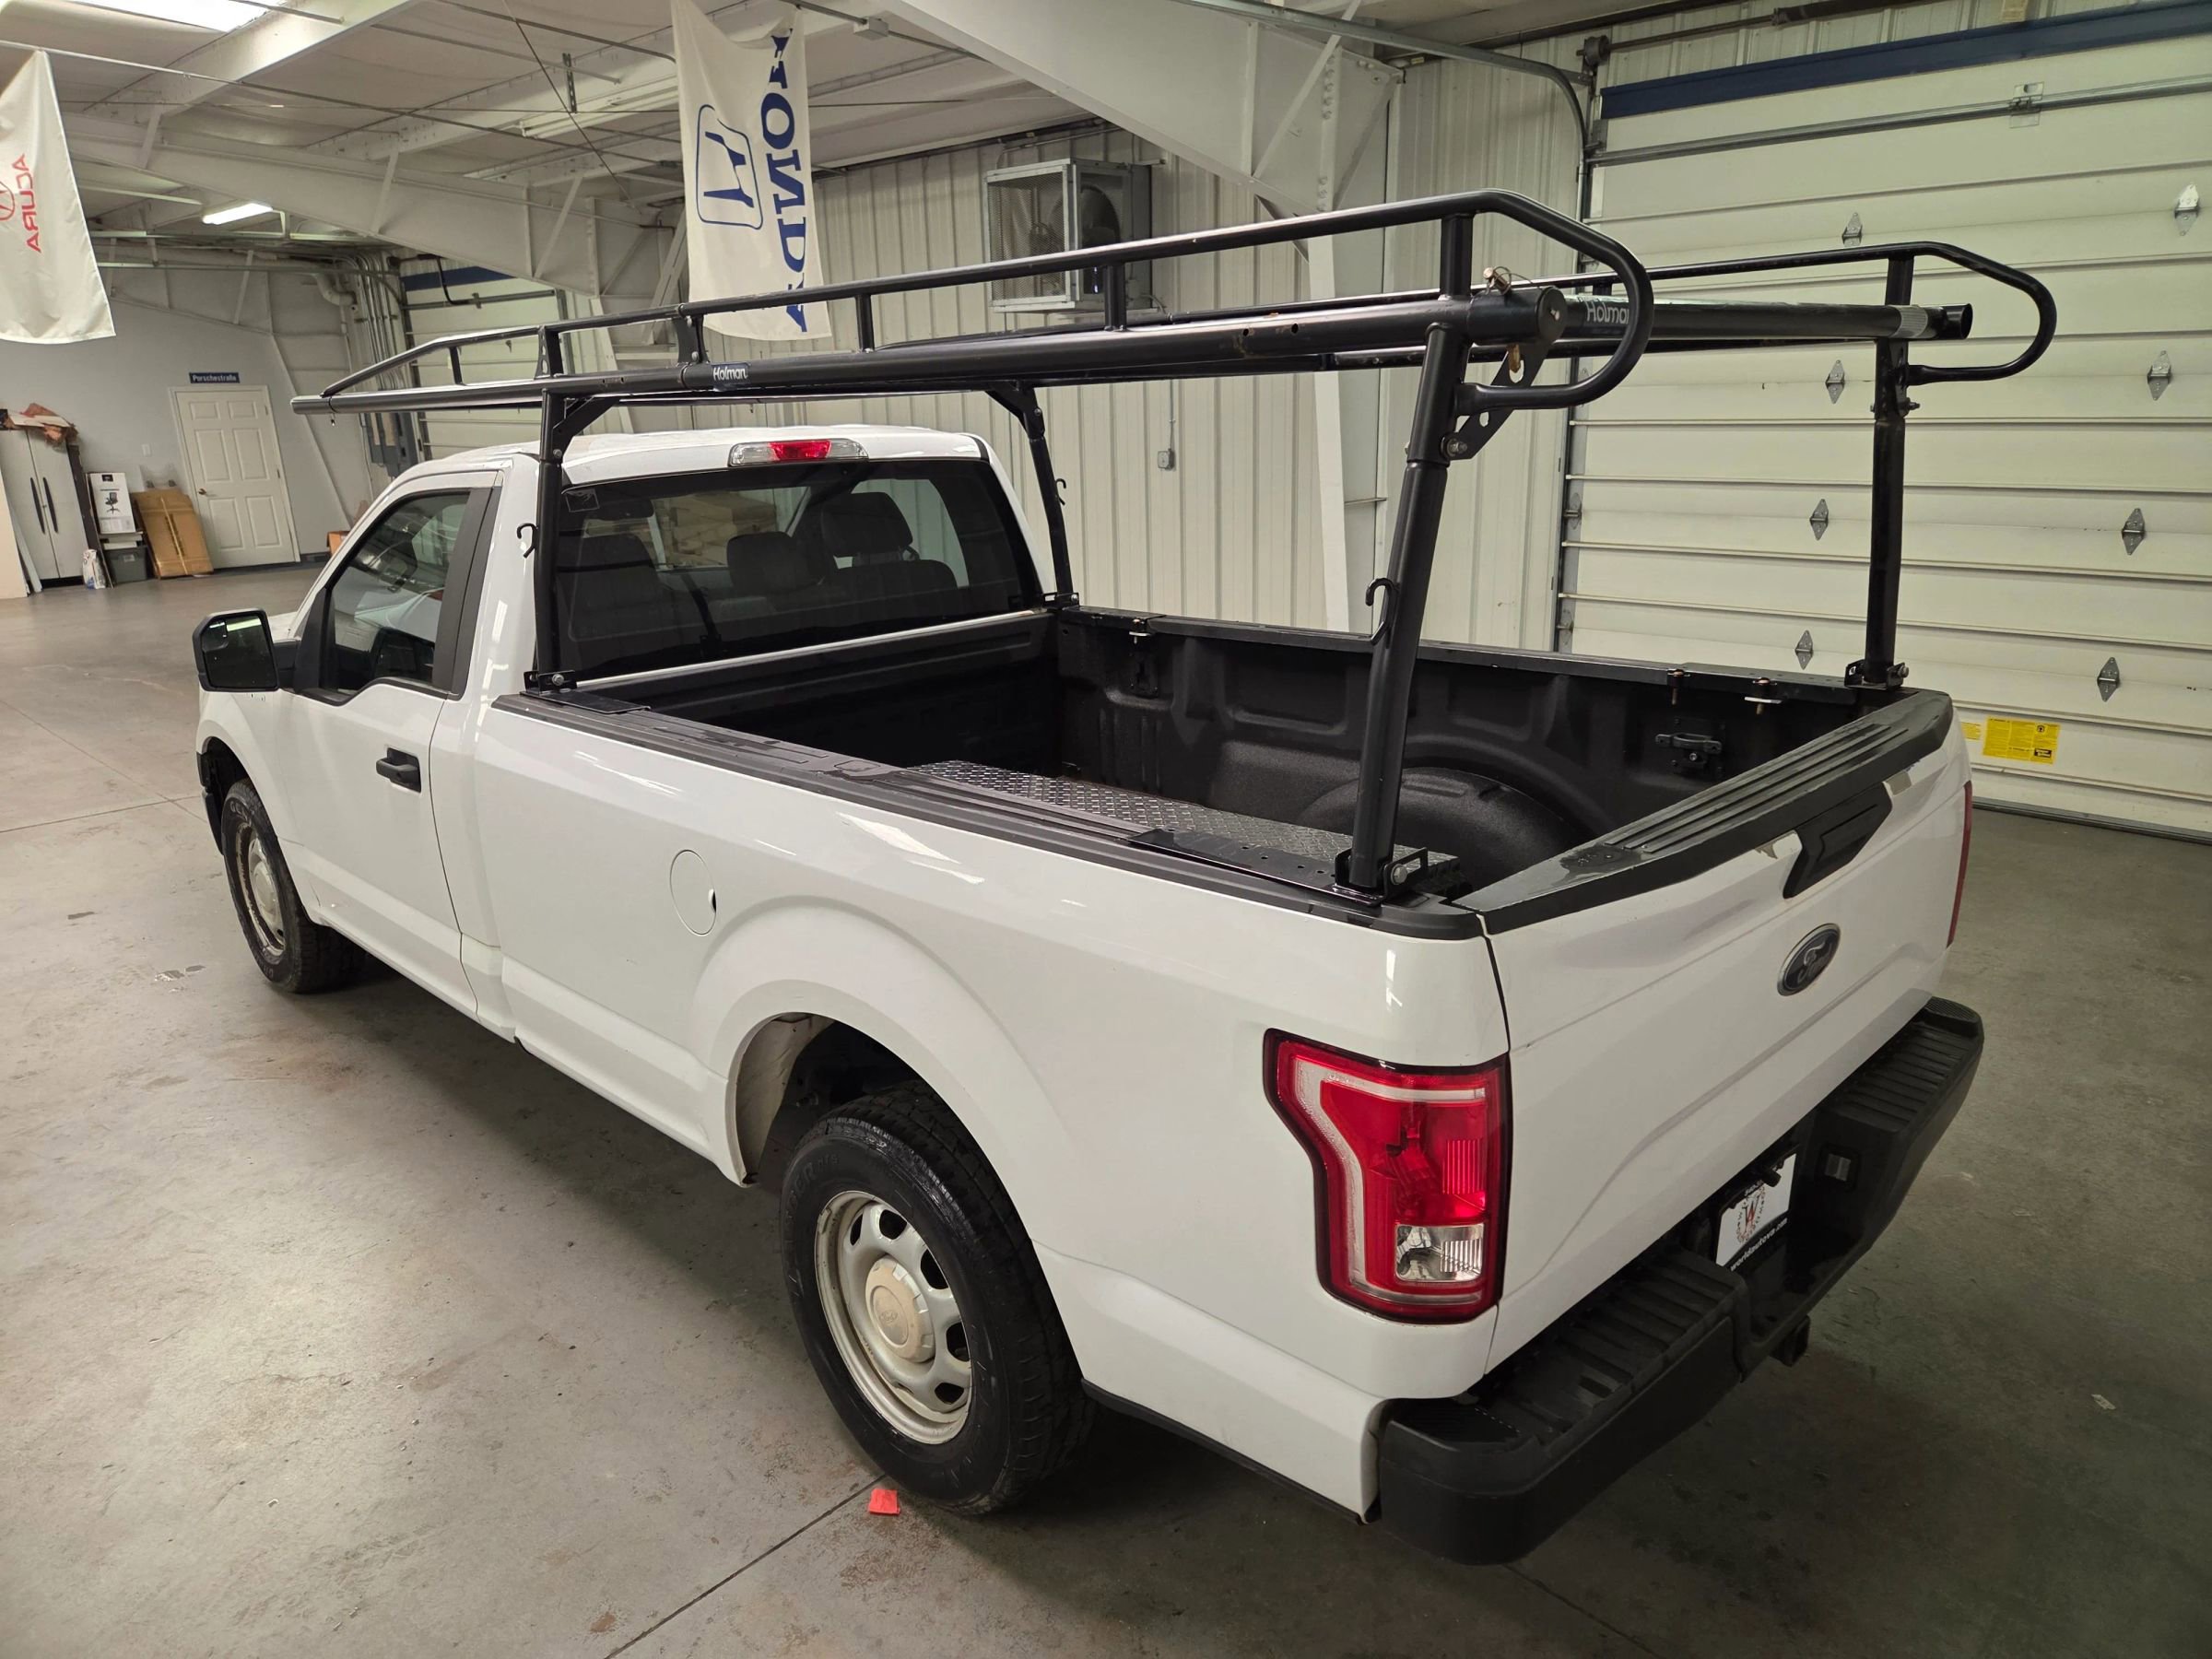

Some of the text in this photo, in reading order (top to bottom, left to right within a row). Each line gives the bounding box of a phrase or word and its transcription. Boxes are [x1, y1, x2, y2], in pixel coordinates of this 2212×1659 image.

[1584, 300, 1630, 324] Holma
[712, 366, 747, 381] Holman
[1729, 1217, 1789, 1272] worldautova.com
